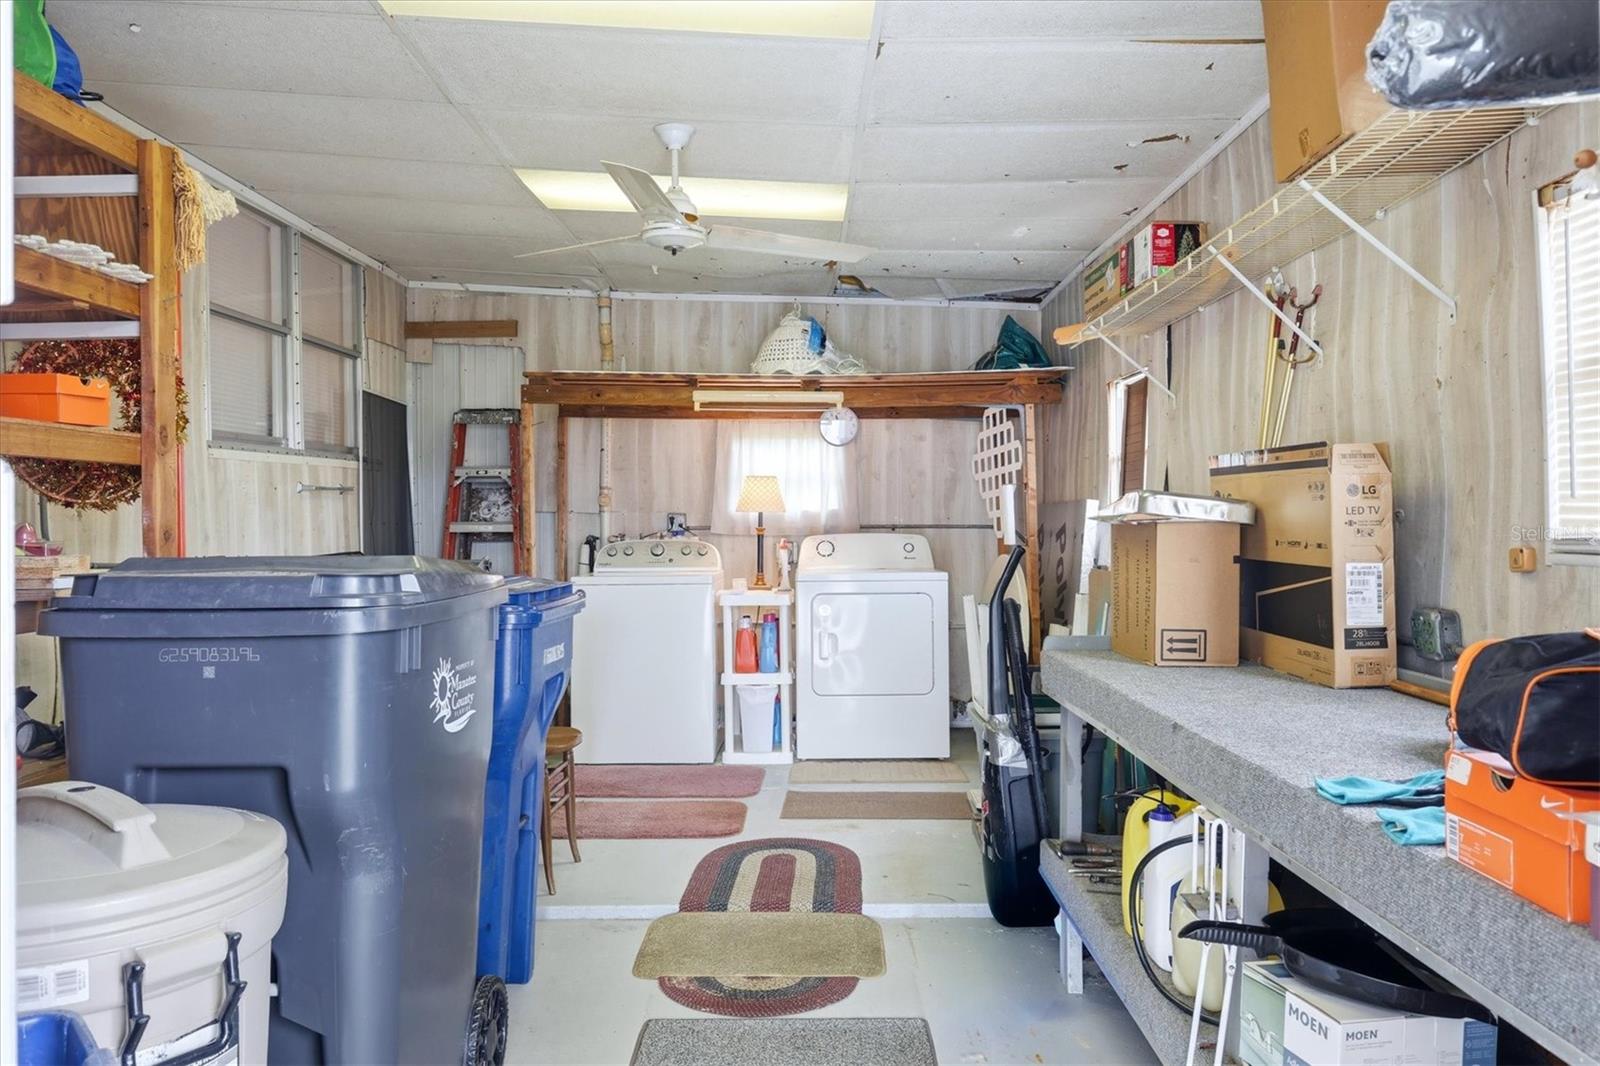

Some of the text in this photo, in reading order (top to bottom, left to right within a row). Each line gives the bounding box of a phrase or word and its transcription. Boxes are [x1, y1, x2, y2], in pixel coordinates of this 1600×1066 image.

[1362, 485, 1377, 495] LG
[1345, 505, 1381, 516] LED TV
[1352, 629, 1364, 638] 28
[451, 691, 474, 710] County
[1288, 1002, 1329, 1041] MOEN
[1345, 1029, 1378, 1041] MOEN
